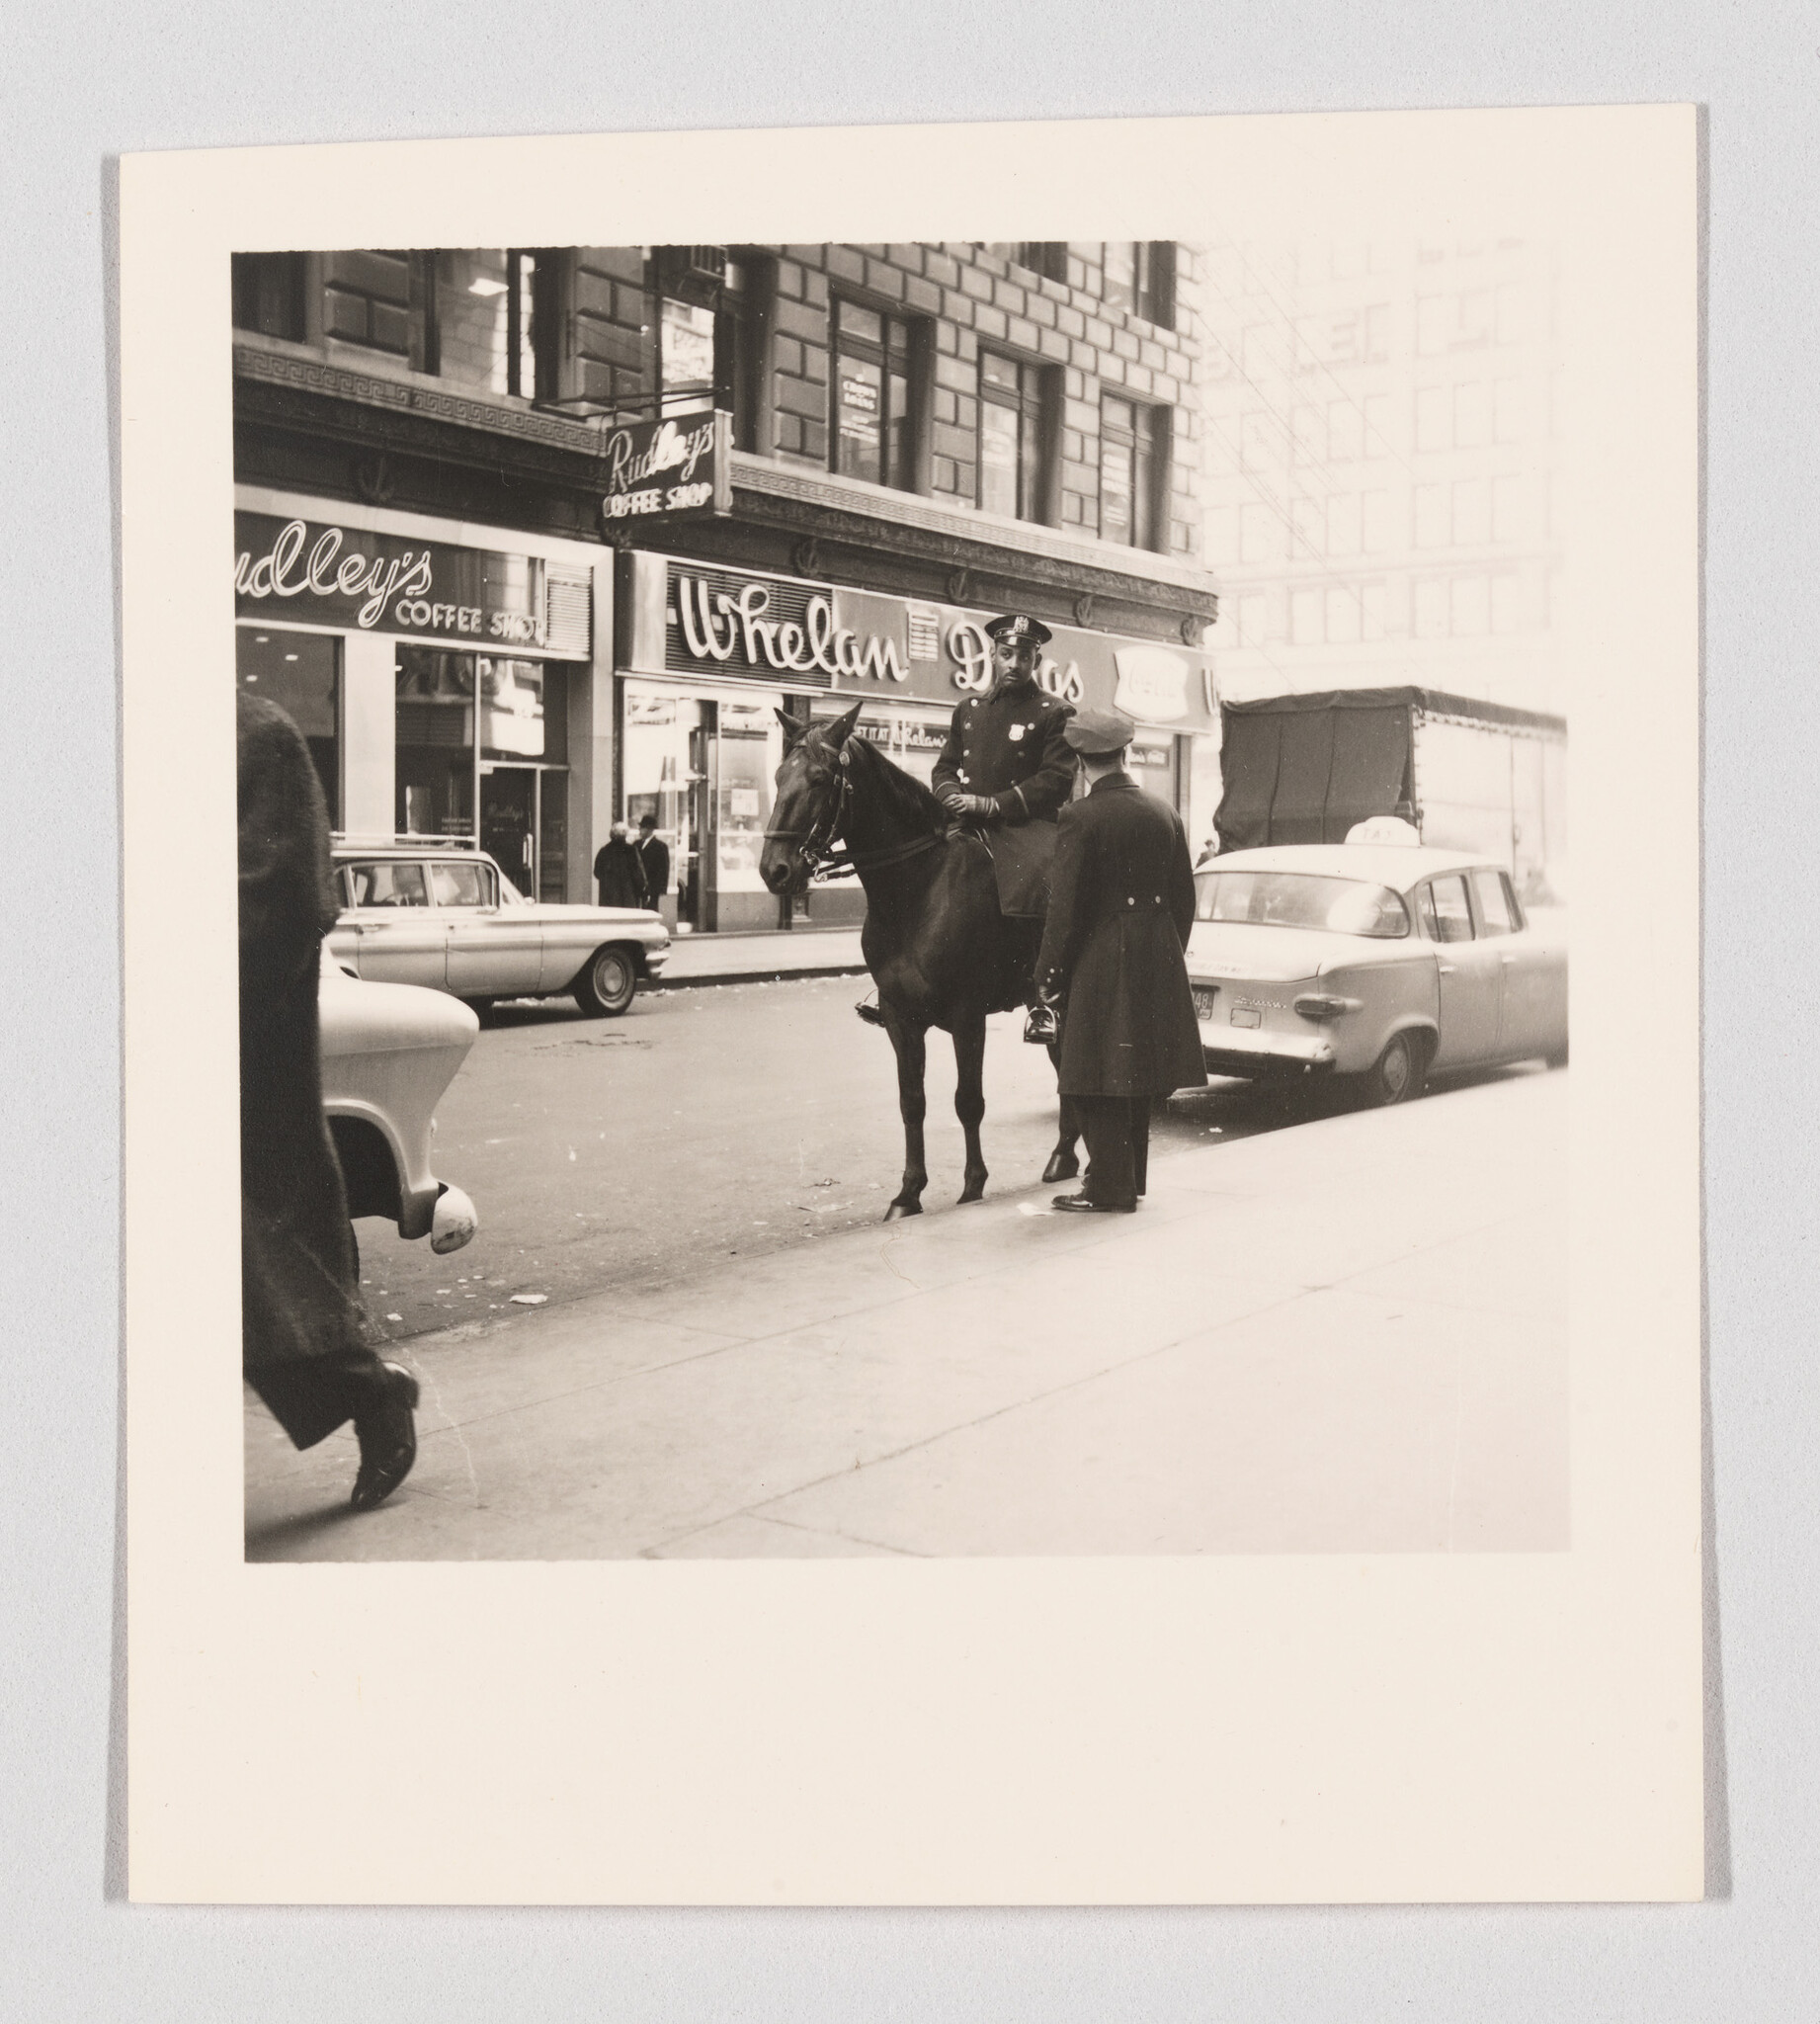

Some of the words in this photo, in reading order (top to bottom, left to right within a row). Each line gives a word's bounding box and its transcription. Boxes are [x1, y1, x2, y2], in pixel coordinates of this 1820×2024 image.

[603, 488, 663, 518] COFFEE
[665, 482, 713, 510] SHOP
[396, 599, 482, 633] COFFEE
[490, 612, 545, 646] SHOP
[679, 576, 910, 682] Whelan
[949, 621, 1085, 703] Dgs
